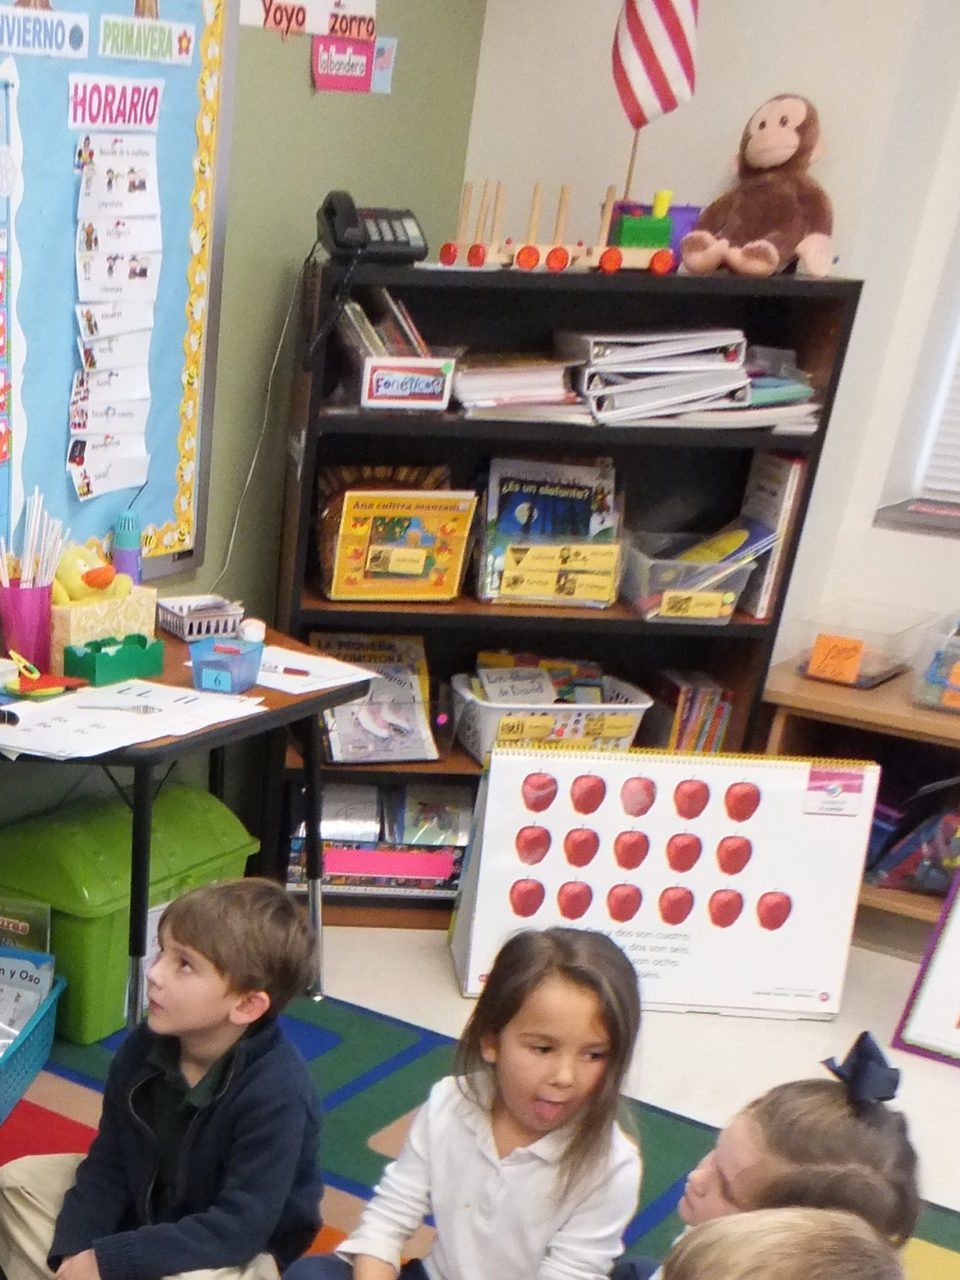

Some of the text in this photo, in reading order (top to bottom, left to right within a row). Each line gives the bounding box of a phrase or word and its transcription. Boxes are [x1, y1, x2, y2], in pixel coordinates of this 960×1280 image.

[262, 0, 306, 36] Yoyo
[330, 13, 375, 37] zorro
[101, 20, 174, 58] PRIMAVERA
[330, 50, 365, 74] bandera
[71, 82, 158, 126] HORARIO
[353, 502, 374, 510] Ana
[214, 676, 222, 686] 6
[615, 930, 633, 938] dos
[629, 944, 646, 952] dos
[650, 945, 668, 953] son
[10, 970, 16, 978] y
[20, 970, 40, 985] Oso
